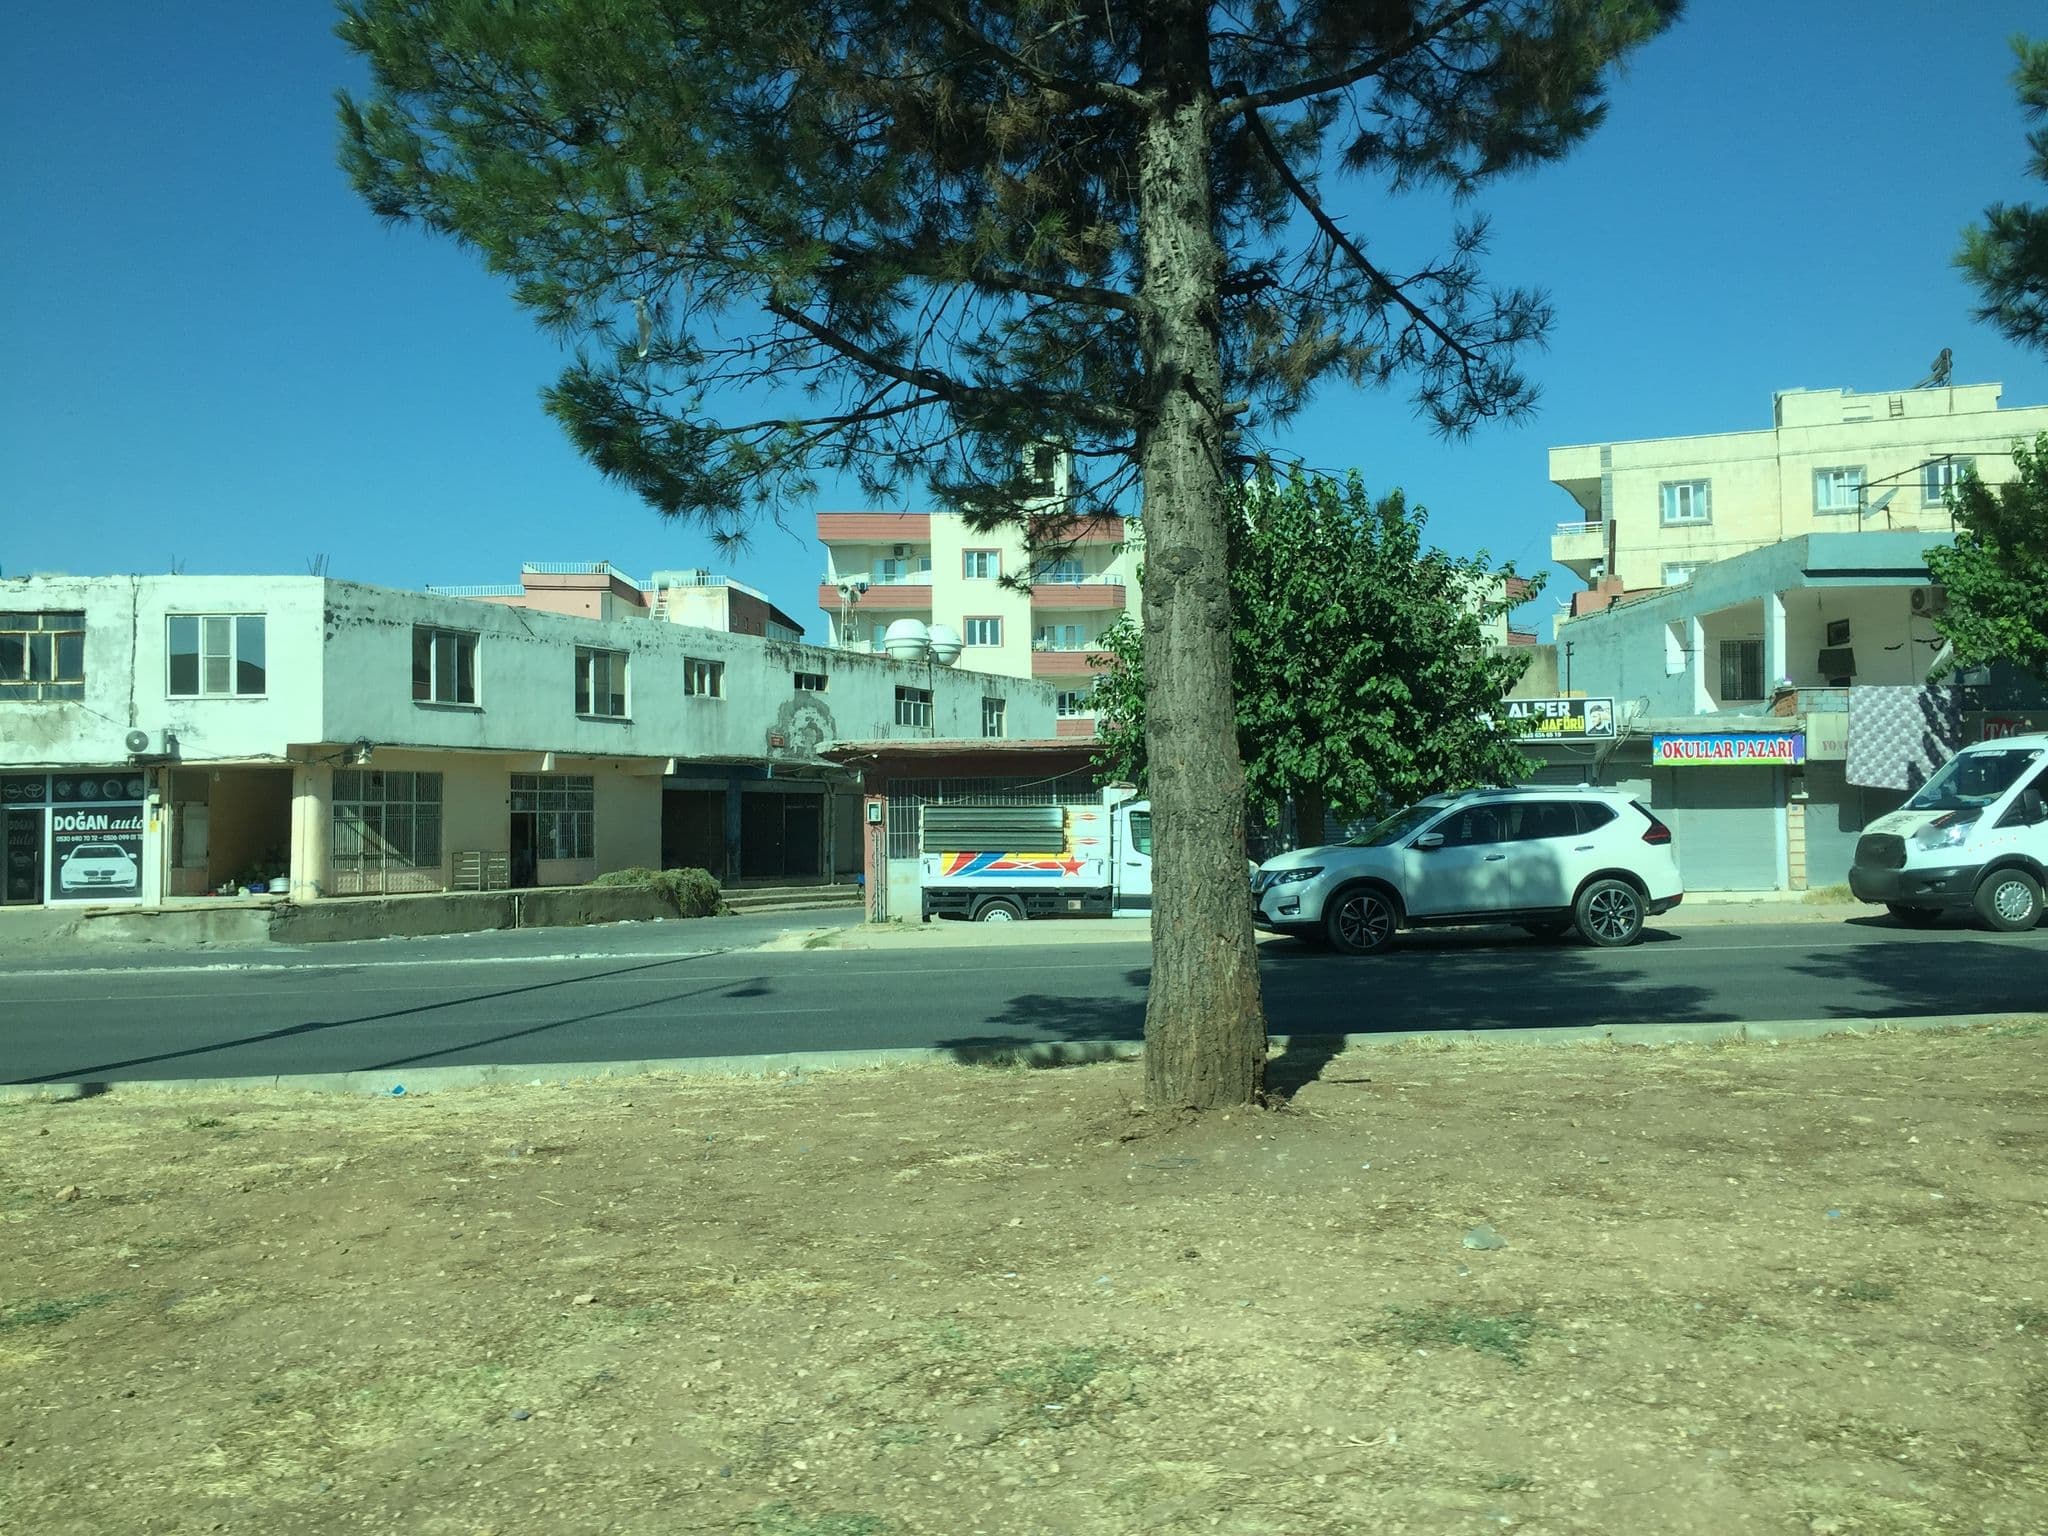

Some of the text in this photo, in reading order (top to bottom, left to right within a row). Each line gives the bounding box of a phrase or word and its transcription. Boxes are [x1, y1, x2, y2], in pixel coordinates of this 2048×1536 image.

[1509, 701, 1571, 718] ALPER
[1662, 740, 1793, 759] OKULLAR PAZARI
[54, 811, 108, 831] DOĞAN
